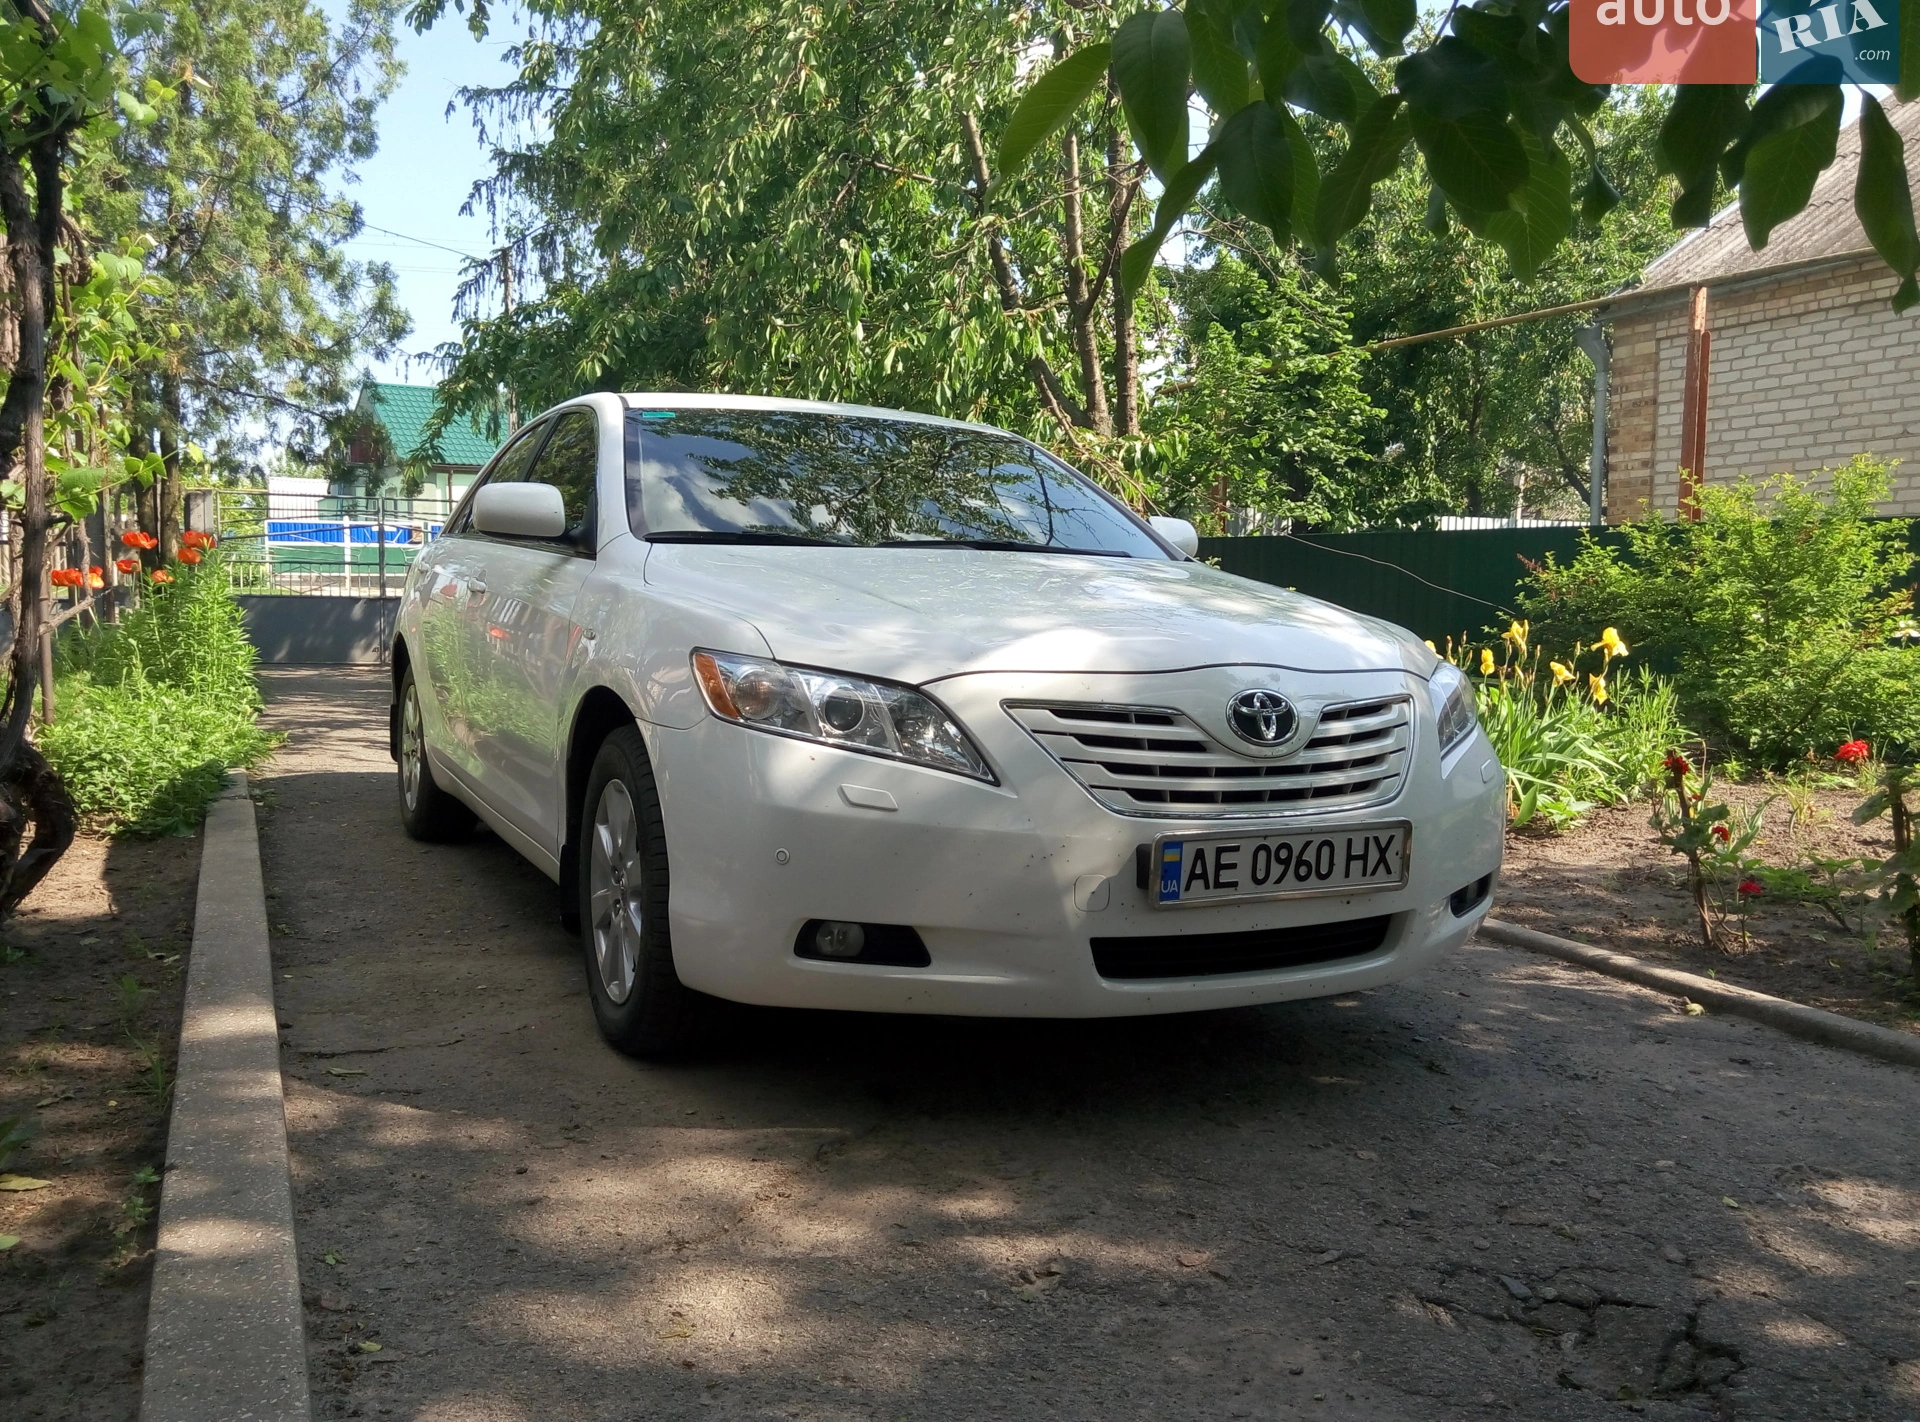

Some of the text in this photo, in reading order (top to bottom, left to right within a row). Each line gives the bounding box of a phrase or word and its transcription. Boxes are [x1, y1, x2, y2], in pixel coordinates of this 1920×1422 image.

[1184, 834, 1396, 892] AE 0960 HX
[1160, 880, 1179, 894] UA
